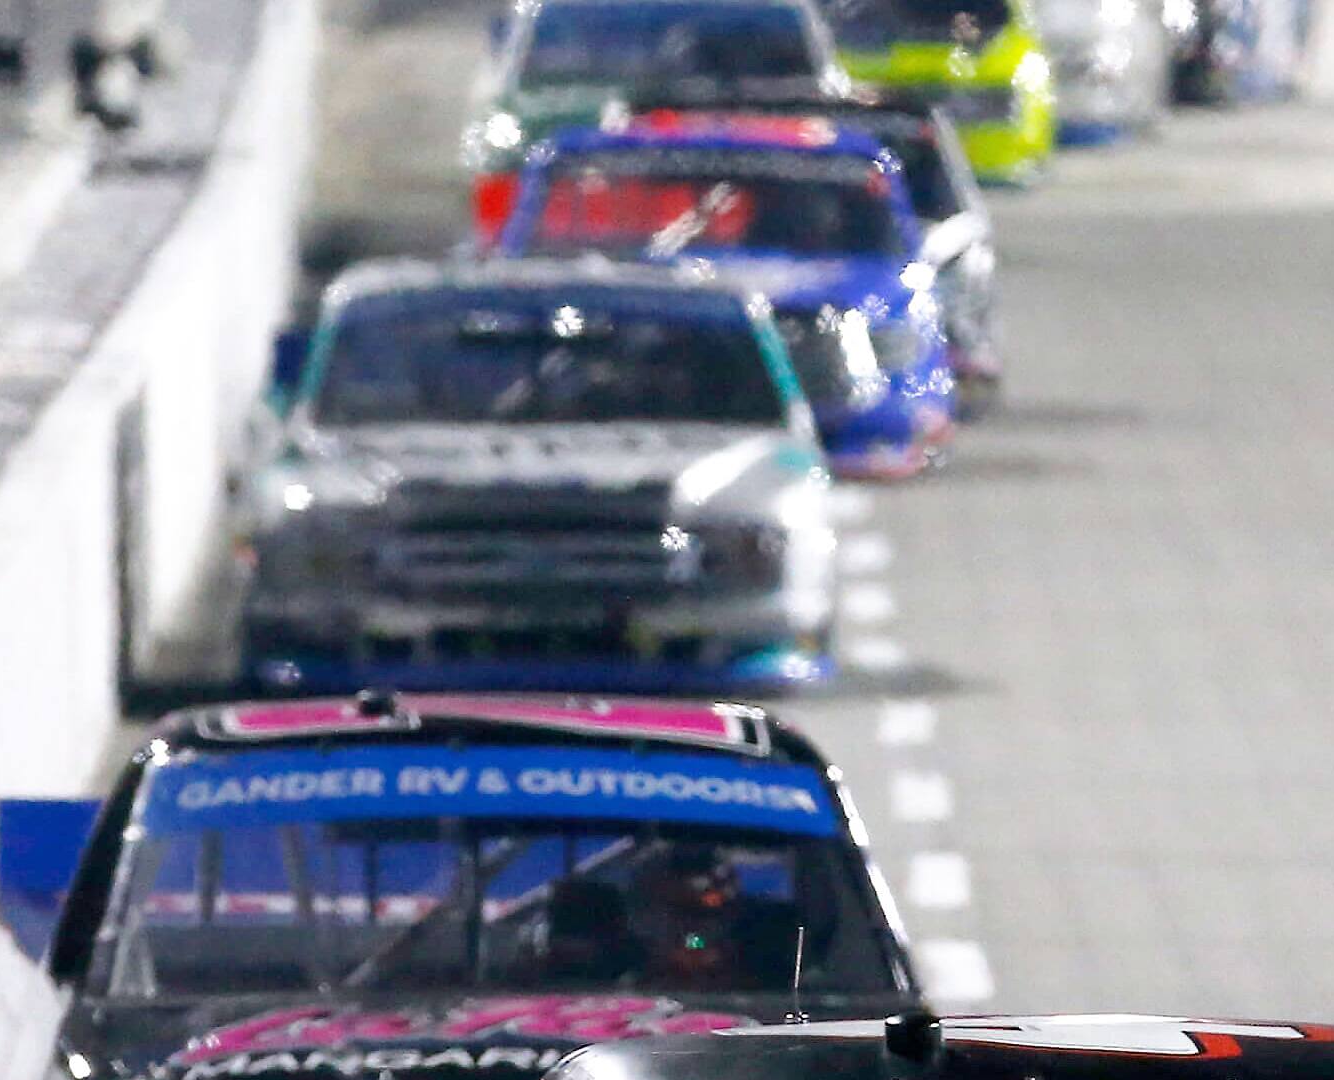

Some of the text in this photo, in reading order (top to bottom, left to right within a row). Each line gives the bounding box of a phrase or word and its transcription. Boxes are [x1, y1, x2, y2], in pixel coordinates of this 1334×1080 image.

[177, 765, 801, 811] GANDER RV & OUTDOORS
